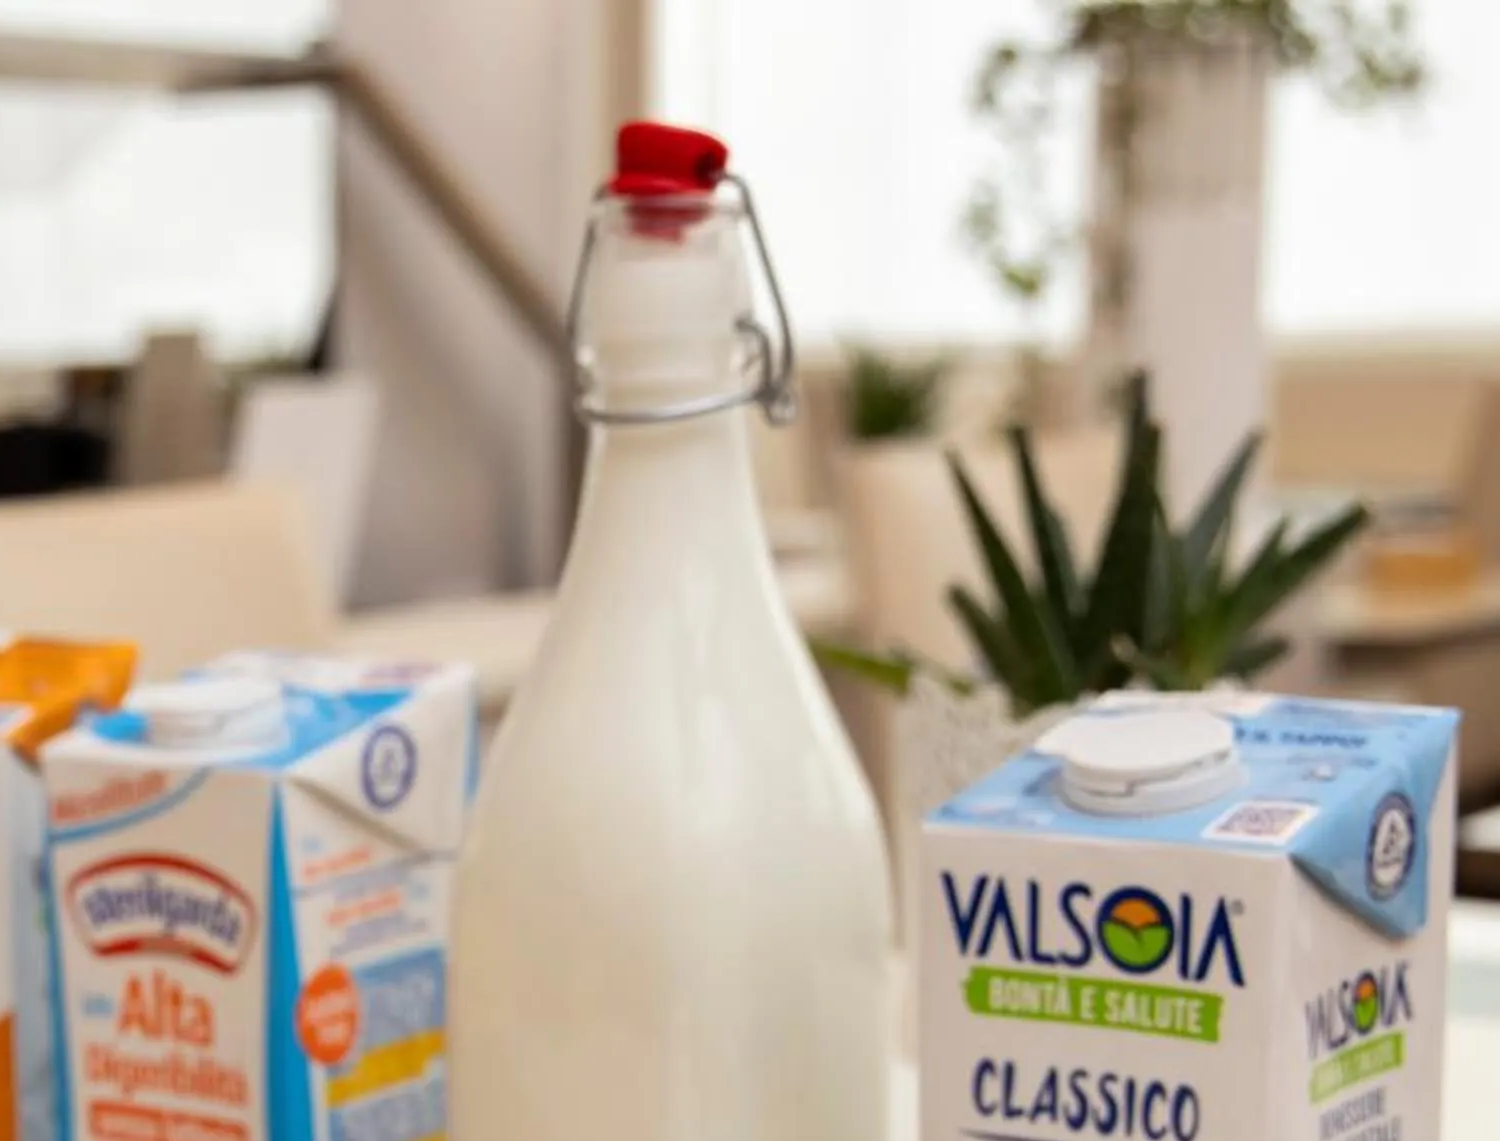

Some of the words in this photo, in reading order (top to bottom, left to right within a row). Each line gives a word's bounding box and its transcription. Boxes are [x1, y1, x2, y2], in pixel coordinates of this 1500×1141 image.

[940, 871, 1246, 987] VALSOIA
[117, 969, 215, 1047] Alta
[988, 974, 1072, 1017] BONTÀ
[1080, 985, 1097, 1023] E
[1103, 988, 1205, 1035] SALUTE
